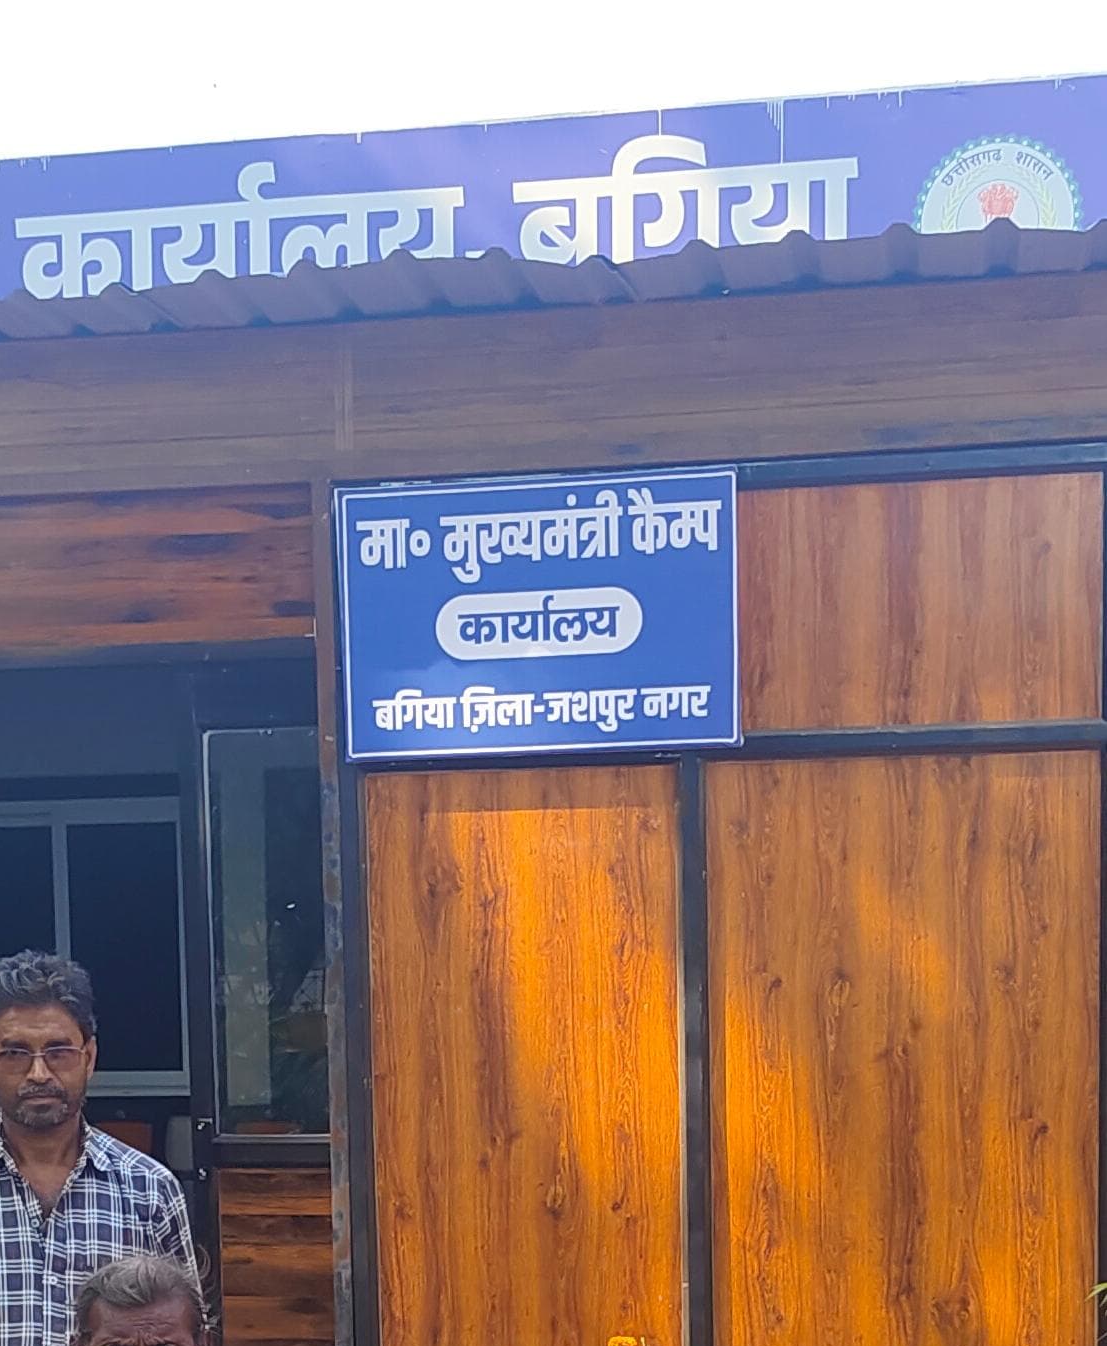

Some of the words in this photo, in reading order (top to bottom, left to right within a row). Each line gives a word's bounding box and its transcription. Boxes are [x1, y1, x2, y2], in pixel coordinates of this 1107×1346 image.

[1015, 150, 1054, 181] शासन
[15, 161, 465, 300] कार्यालय
[512, 134, 859, 267] बगिया
[439, 489, 623, 584] मुख्यमंत्री
[627, 487, 723, 556] कैम्प
[457, 594, 621, 646] कार्यालय
[373, 690, 457, 731] बगिया
[641, 685, 712, 719] नगर
